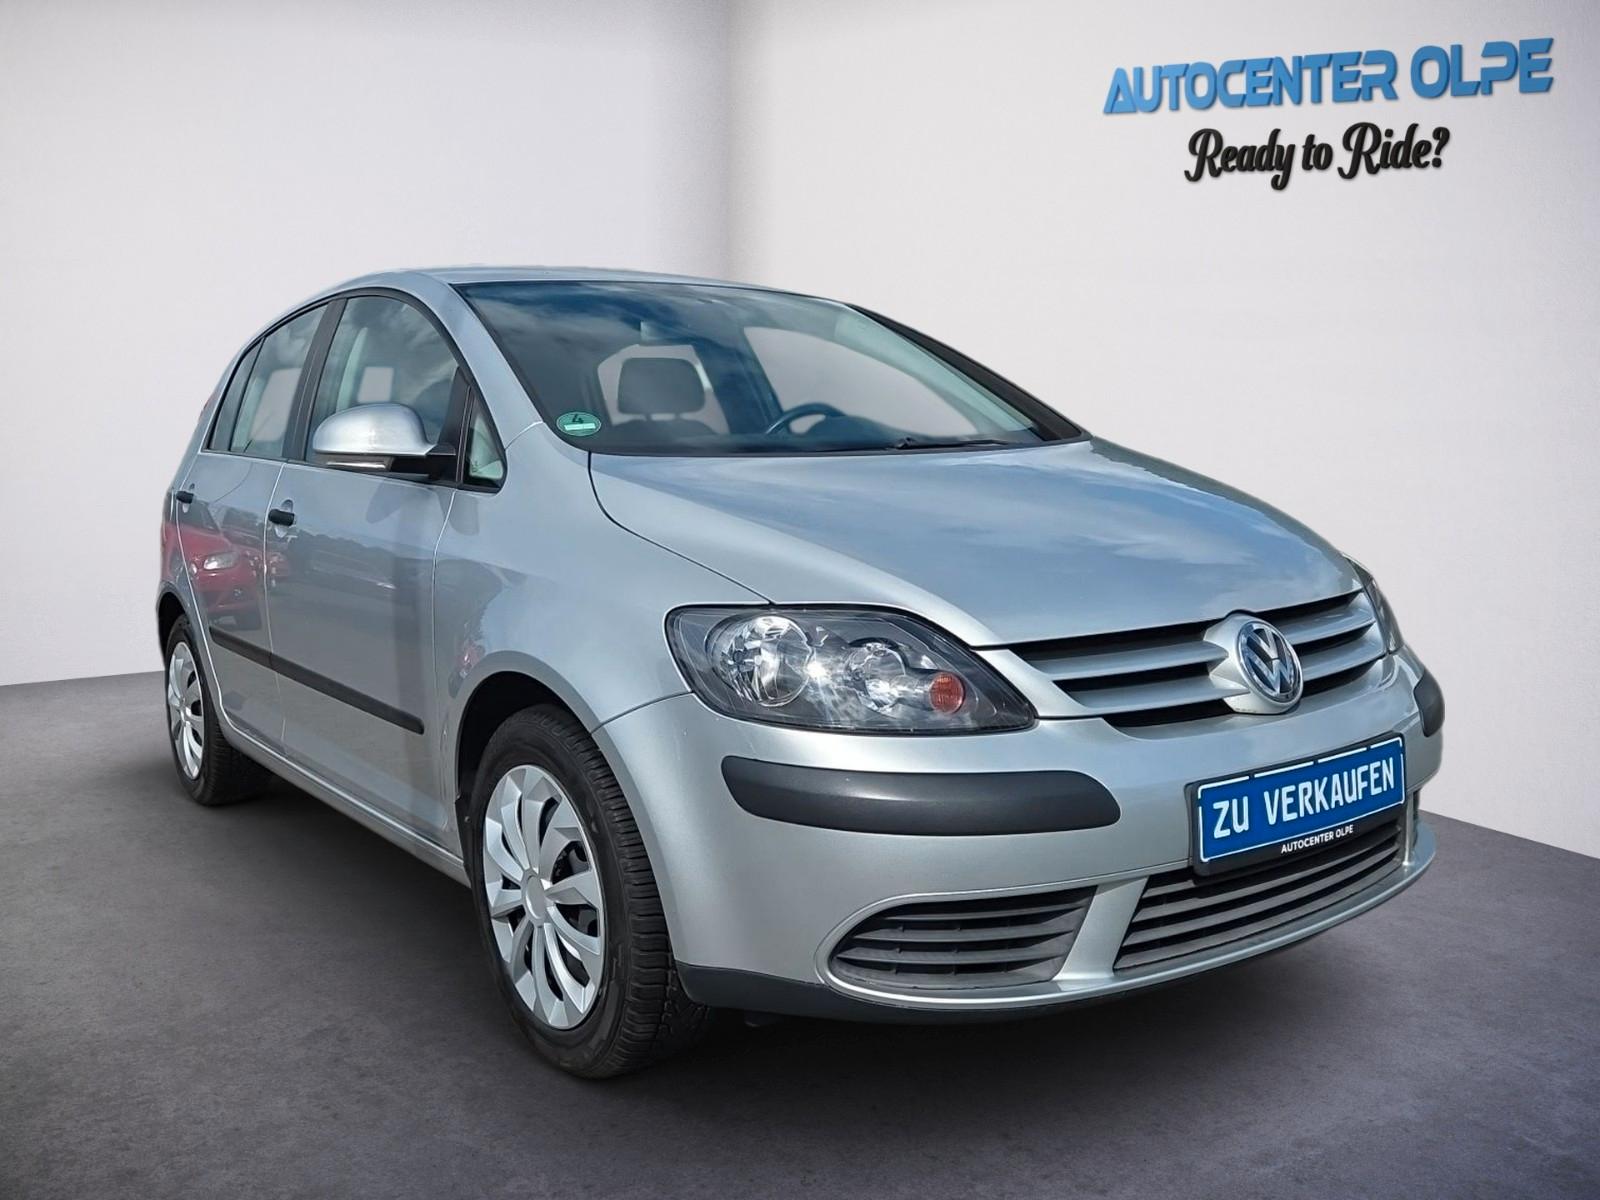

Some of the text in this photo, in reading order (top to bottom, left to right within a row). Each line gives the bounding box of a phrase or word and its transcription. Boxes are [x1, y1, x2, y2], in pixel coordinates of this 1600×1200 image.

[1103, 37, 1554, 114] AUTOCENTER OLPE
[1184, 121, 1450, 190] Ready to Ride?
[1212, 757, 1395, 839] ZU VERKAUFEN
[1281, 824, 1354, 854] AUTOCENTER OLPE
